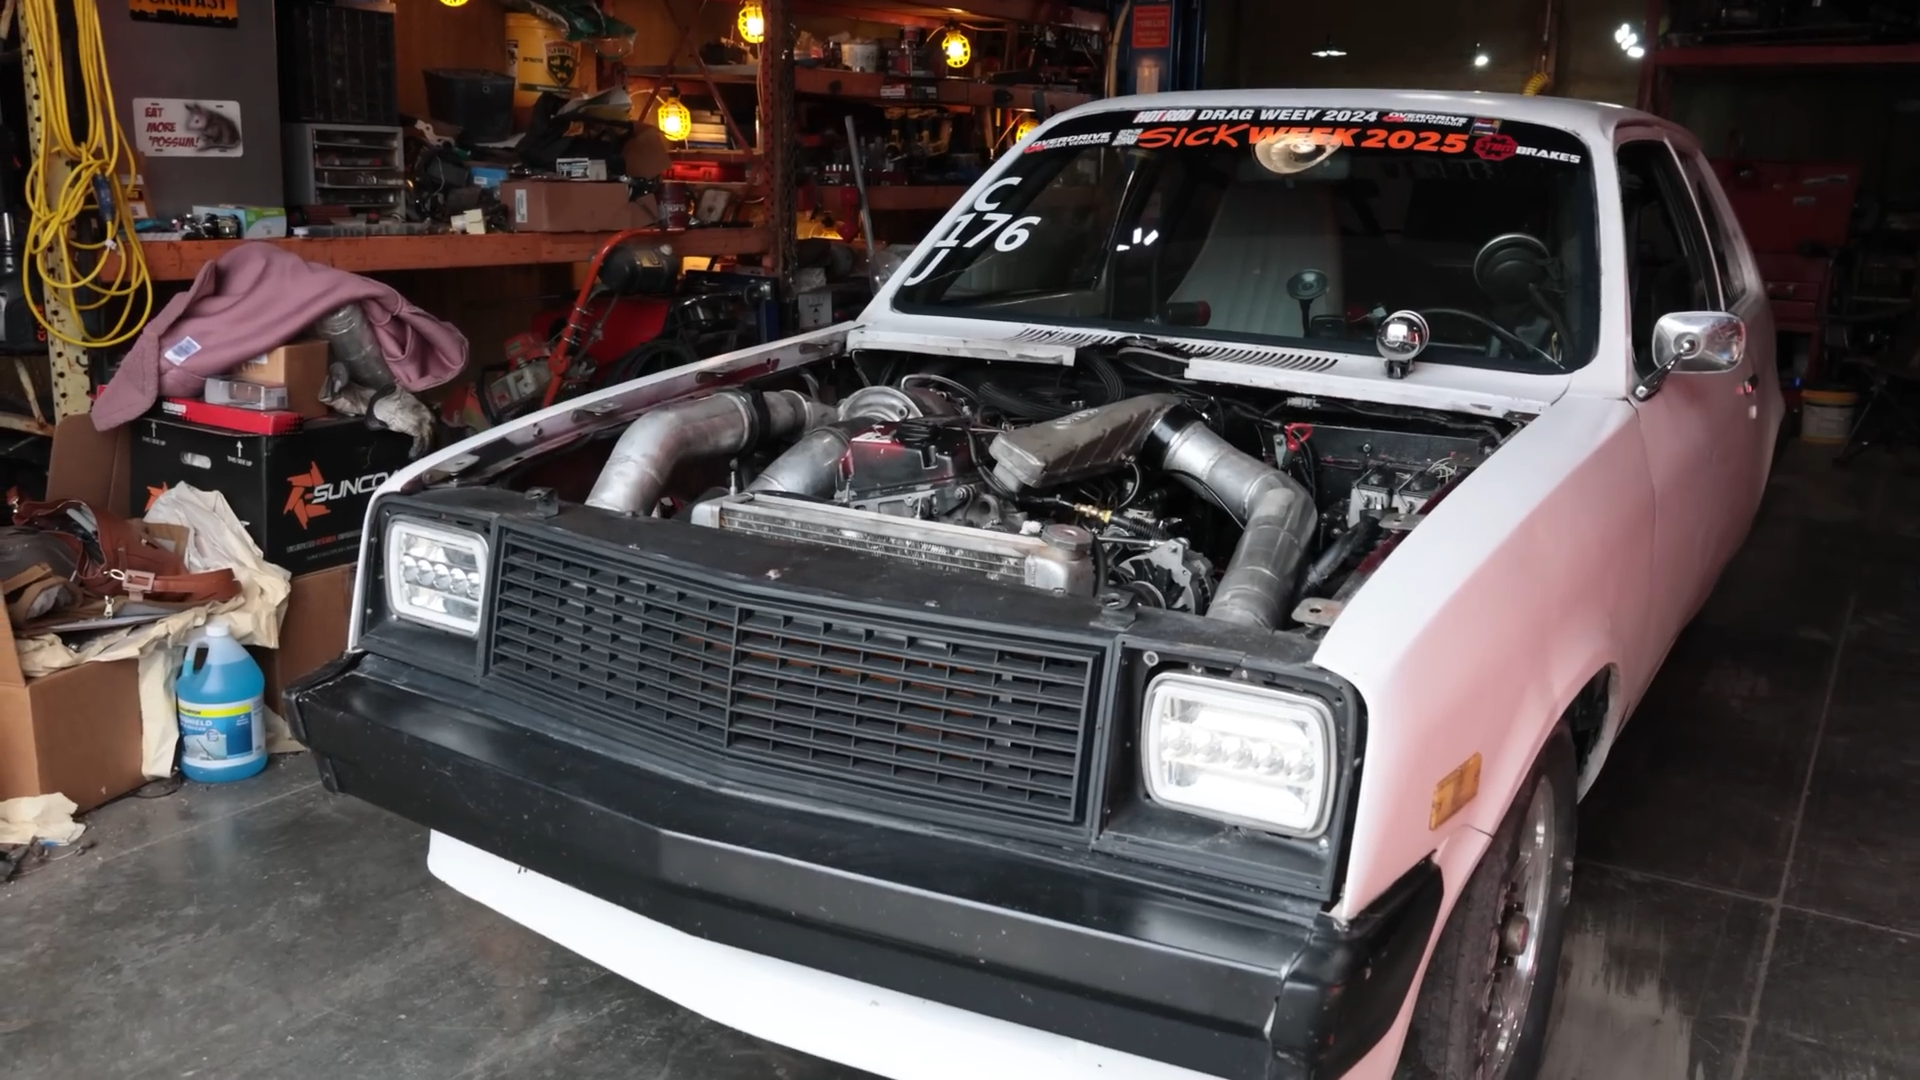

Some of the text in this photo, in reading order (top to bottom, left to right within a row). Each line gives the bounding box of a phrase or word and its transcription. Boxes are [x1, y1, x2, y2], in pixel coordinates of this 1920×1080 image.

[145, 107, 164, 118] EAT
[1133, 109, 1379, 123] HOT ROD DRAG WEEK 2024
[1388, 112, 1468, 123] OVERDRIVE
[146, 122, 176, 133] MORE
[1031, 131, 1112, 147] OVERDRIVE
[1138, 123, 1469, 154] SICK WEEK 2025
[1515, 145, 1581, 164] BRAKES
[974, 177, 1023, 212] C
[934, 212, 1042, 252] 176
[312, 471, 390, 504] SUNCO
